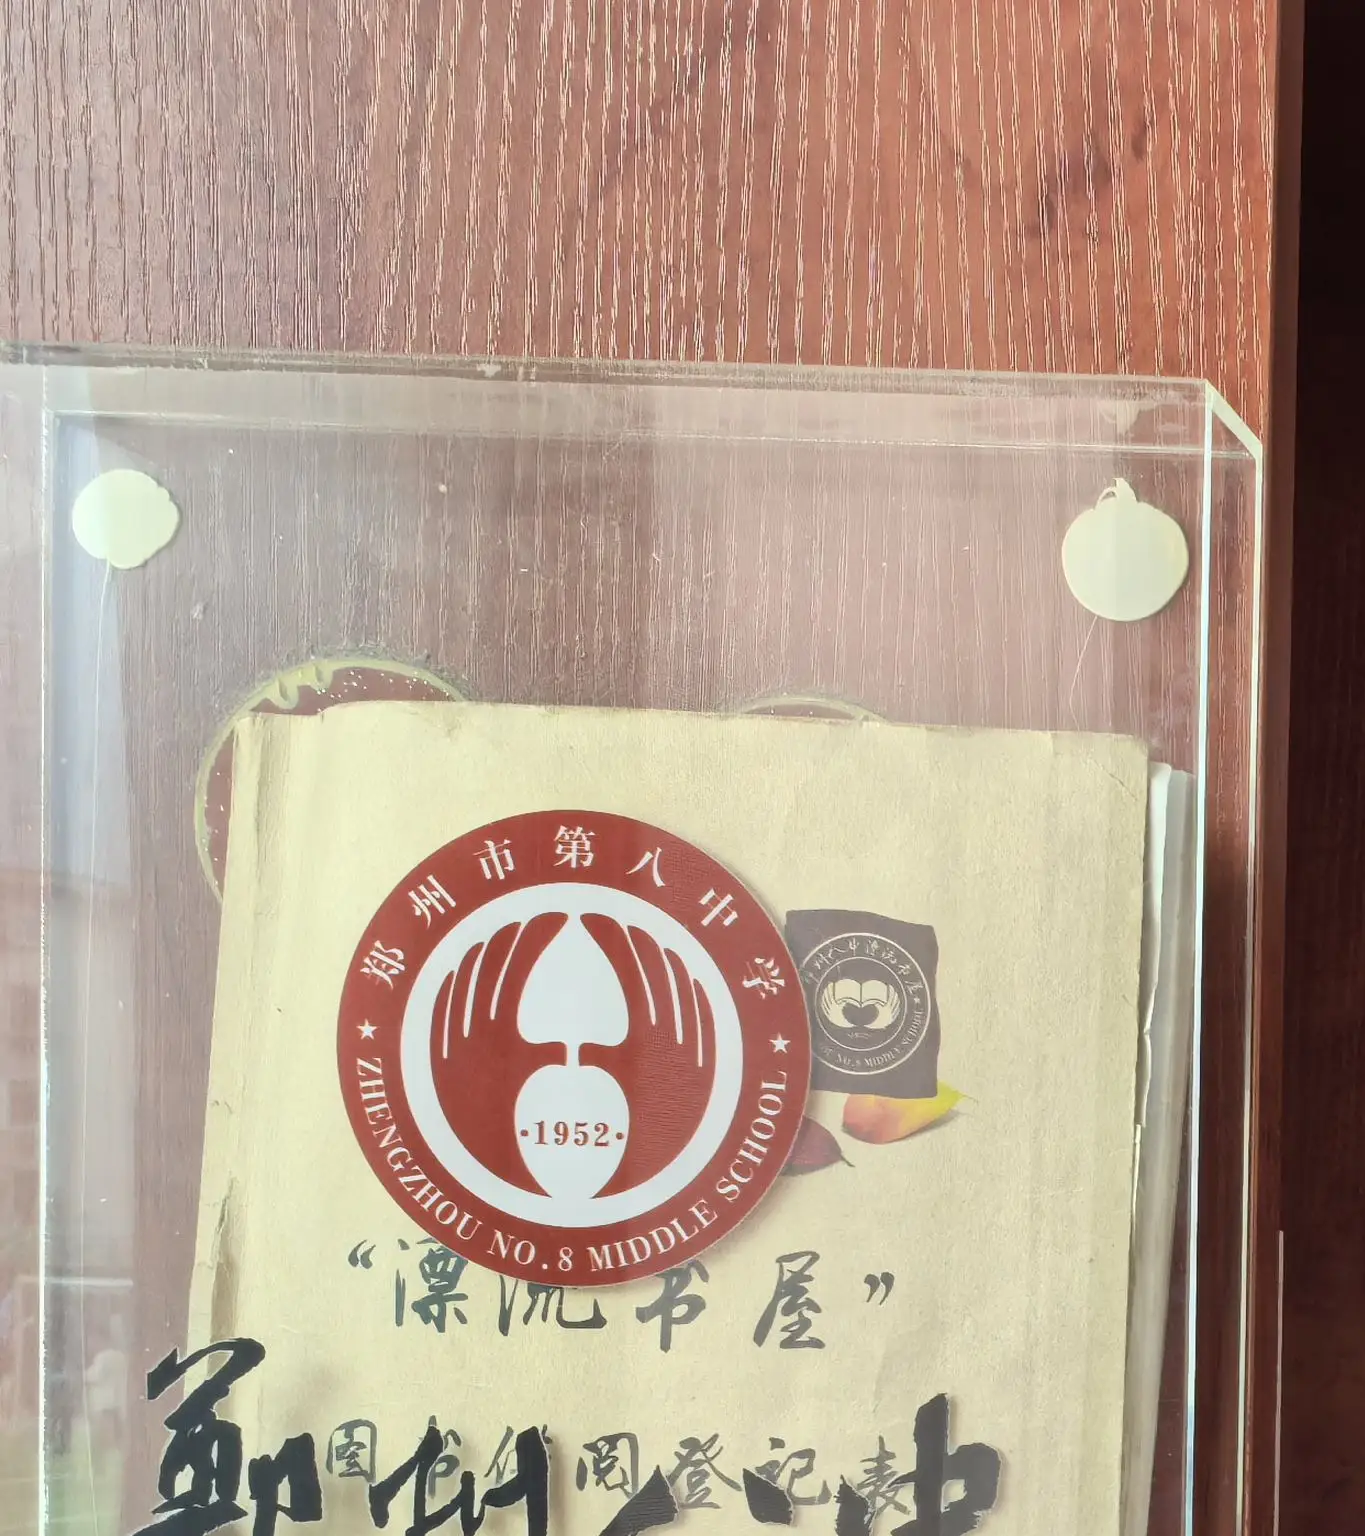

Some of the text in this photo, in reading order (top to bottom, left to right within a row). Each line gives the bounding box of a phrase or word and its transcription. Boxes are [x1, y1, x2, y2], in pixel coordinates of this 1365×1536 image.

[360, 825, 786, 1000] 郑州市第八中学
[356, 1056, 787, 1272] ZHENGZHOU NO.8 MIDDLE SCHOOL
